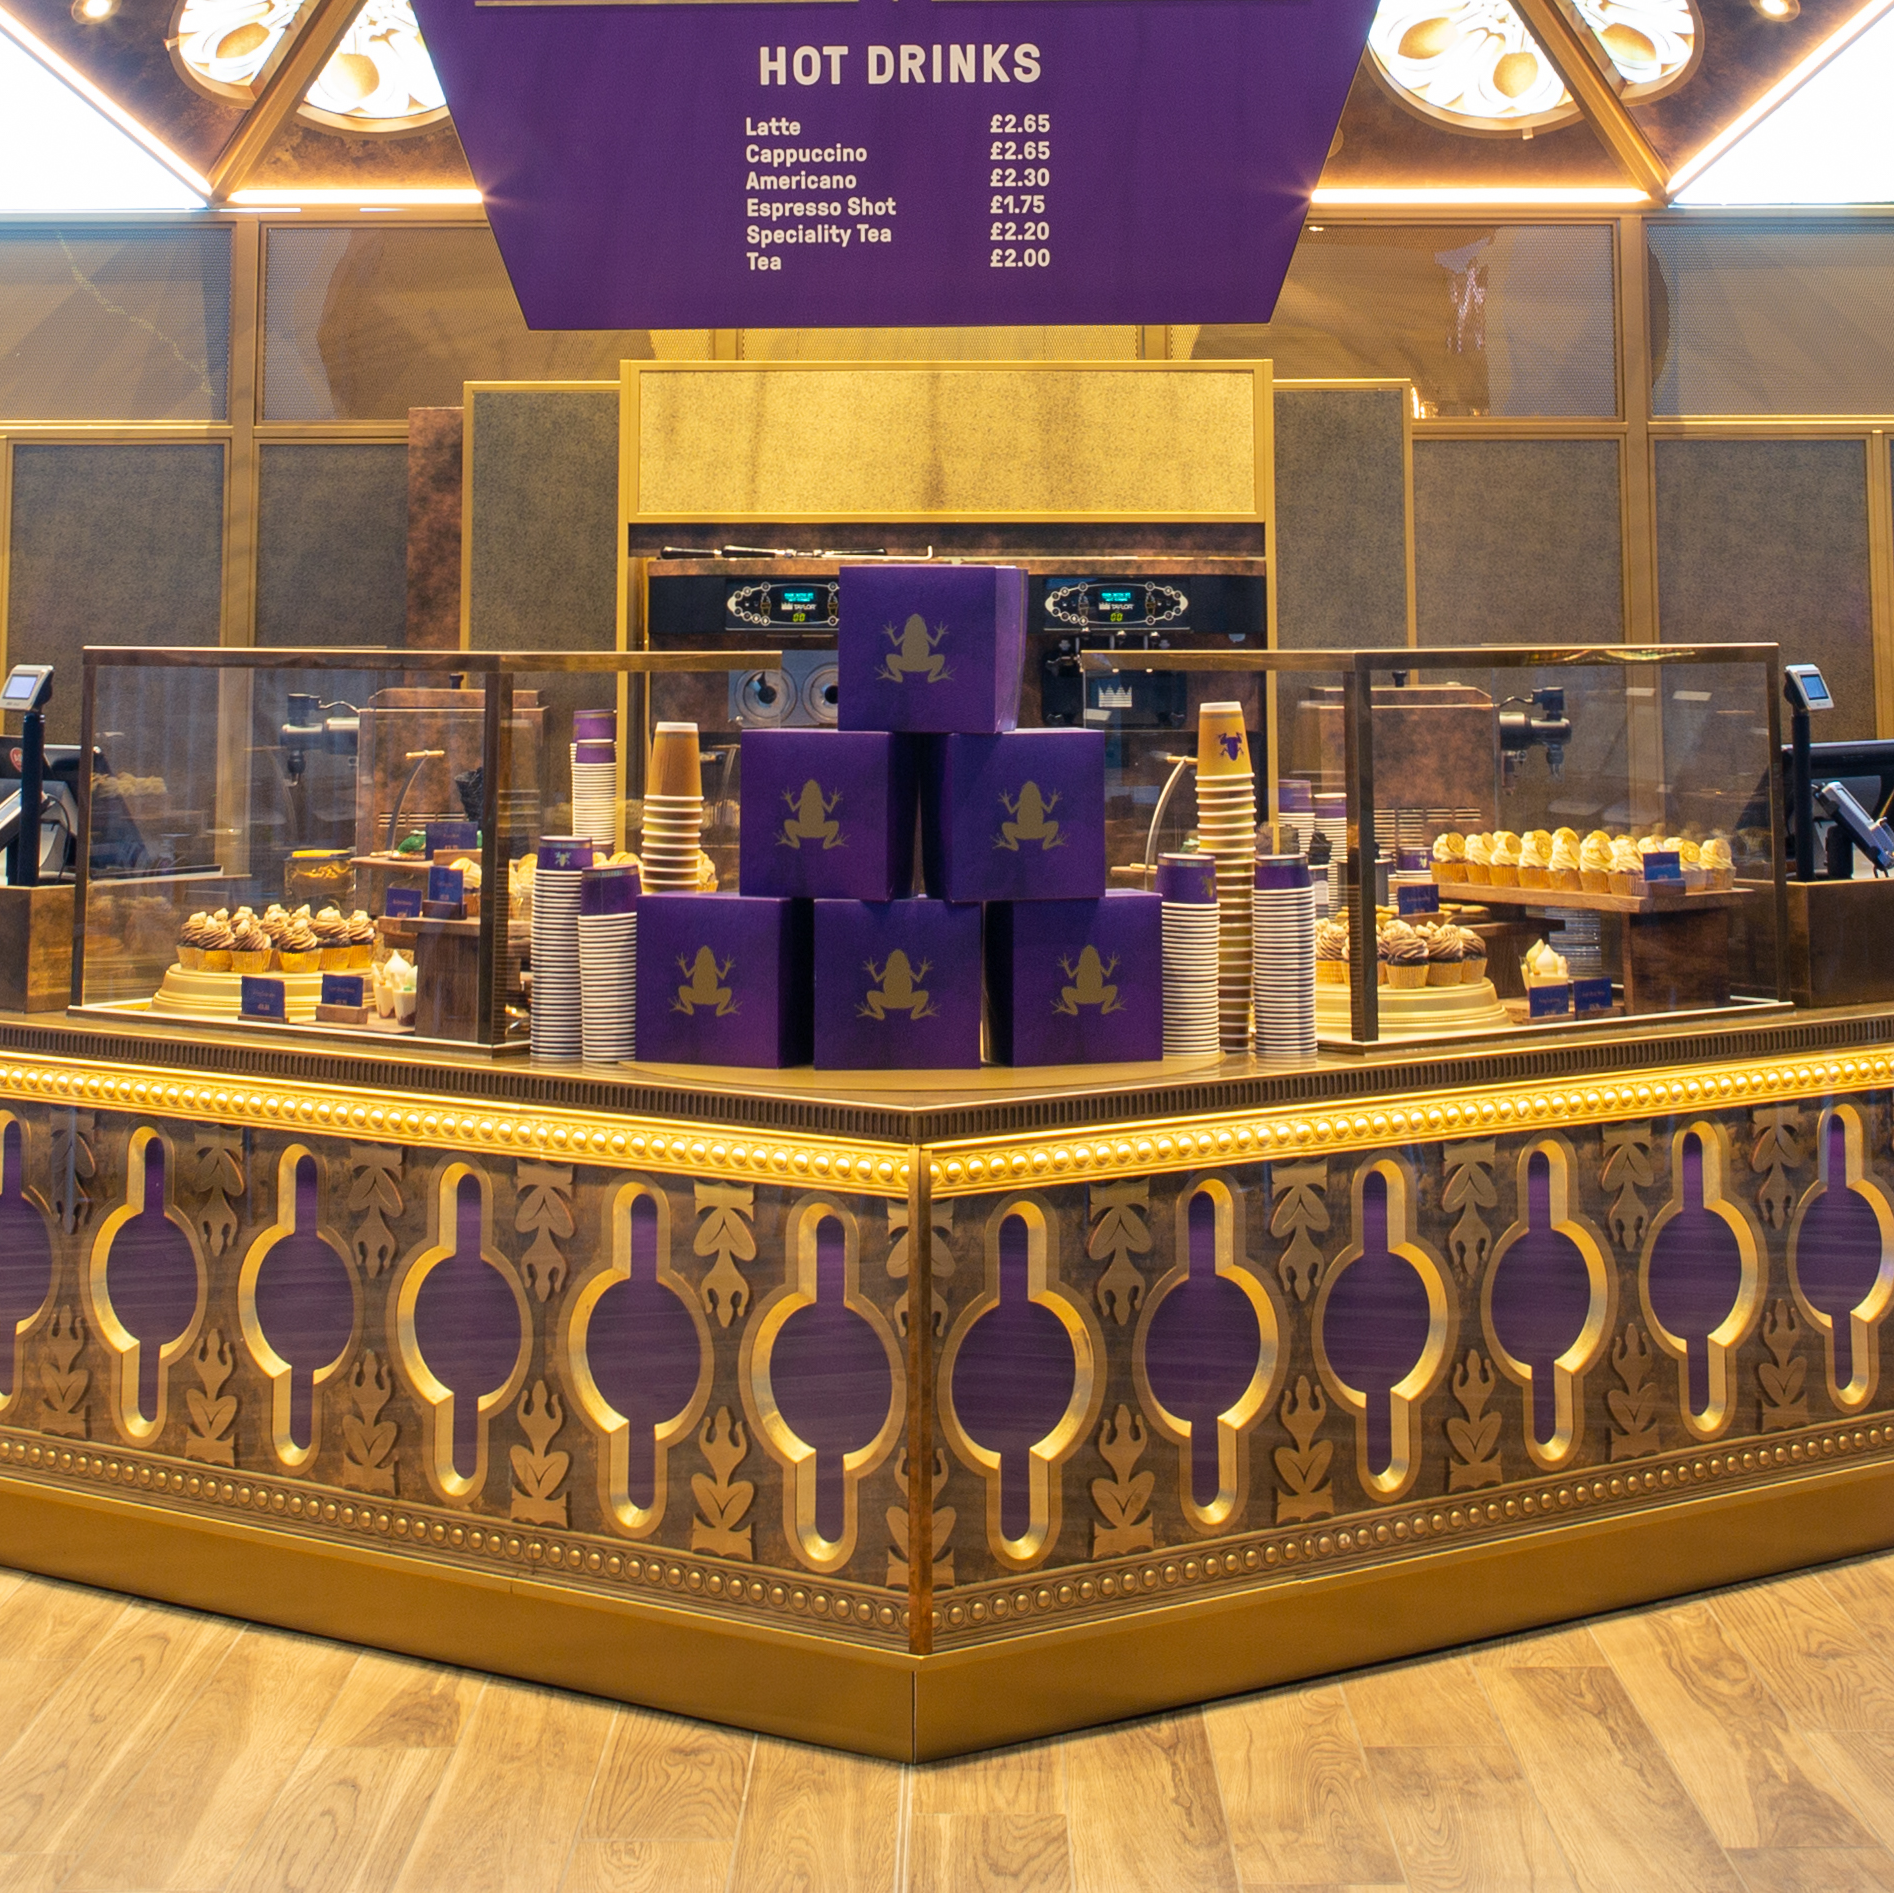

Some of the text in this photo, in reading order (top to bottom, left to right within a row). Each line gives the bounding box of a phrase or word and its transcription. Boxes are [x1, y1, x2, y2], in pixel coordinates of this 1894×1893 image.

[759, 43, 1041, 86] HOT DRINKS
[745, 113, 1051, 136] Latte £2.65
[745, 140, 1051, 168] Cappuccino £2.65
[745, 167, 1050, 191] Americano £2.30
[746, 194, 1046, 222] Espresso Shot £1.75
[746, 221, 1050, 249] Speciality Tea £2.20
[746, 248, 1051, 271] Tea £2.00
